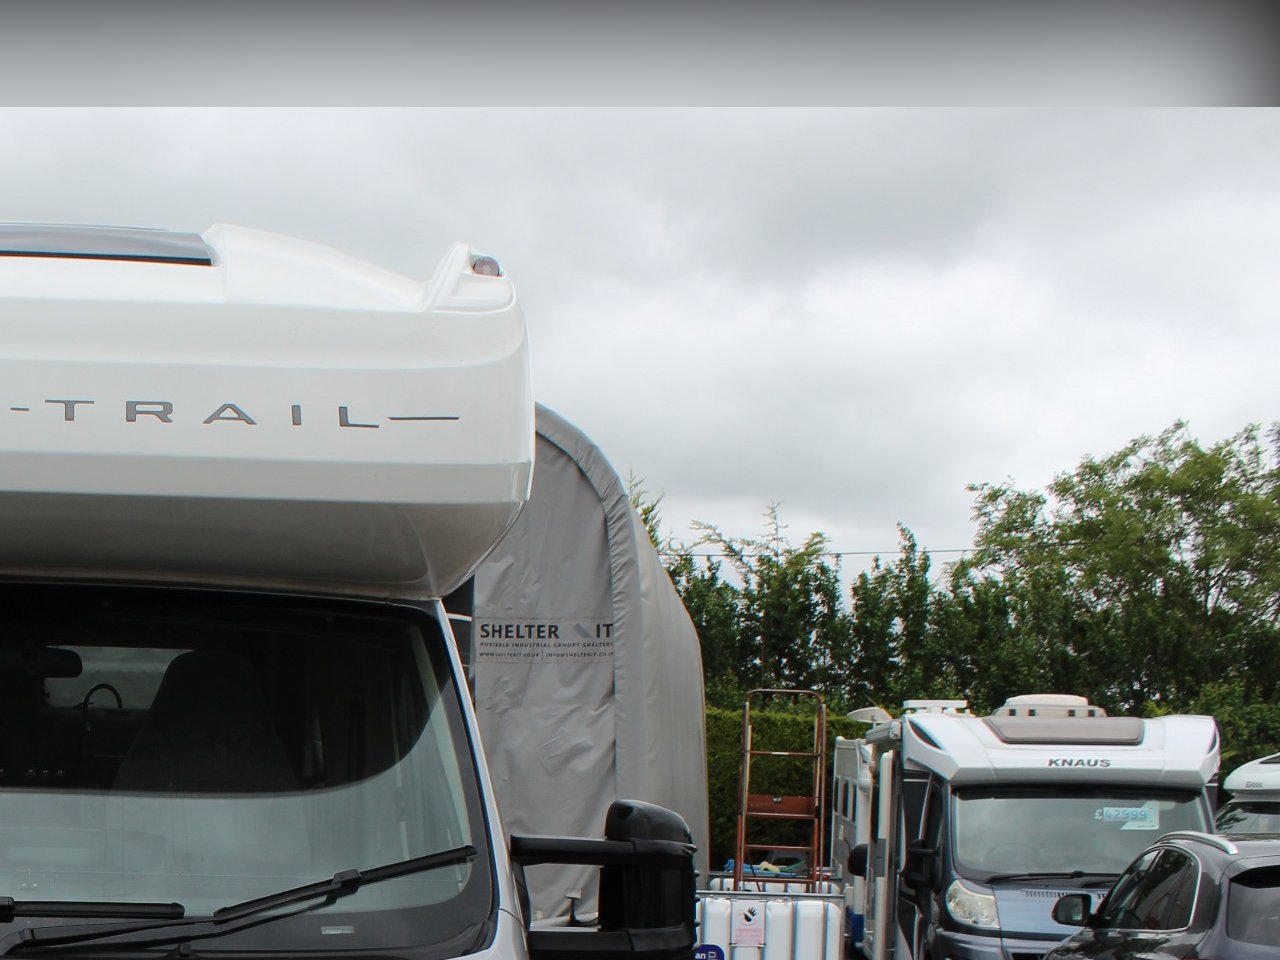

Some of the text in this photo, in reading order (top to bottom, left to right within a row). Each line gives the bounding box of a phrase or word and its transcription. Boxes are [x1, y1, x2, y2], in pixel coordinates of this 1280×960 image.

[479, 623, 613, 639] SHELTER IT
[1048, 758, 1111, 768] KNAUS
